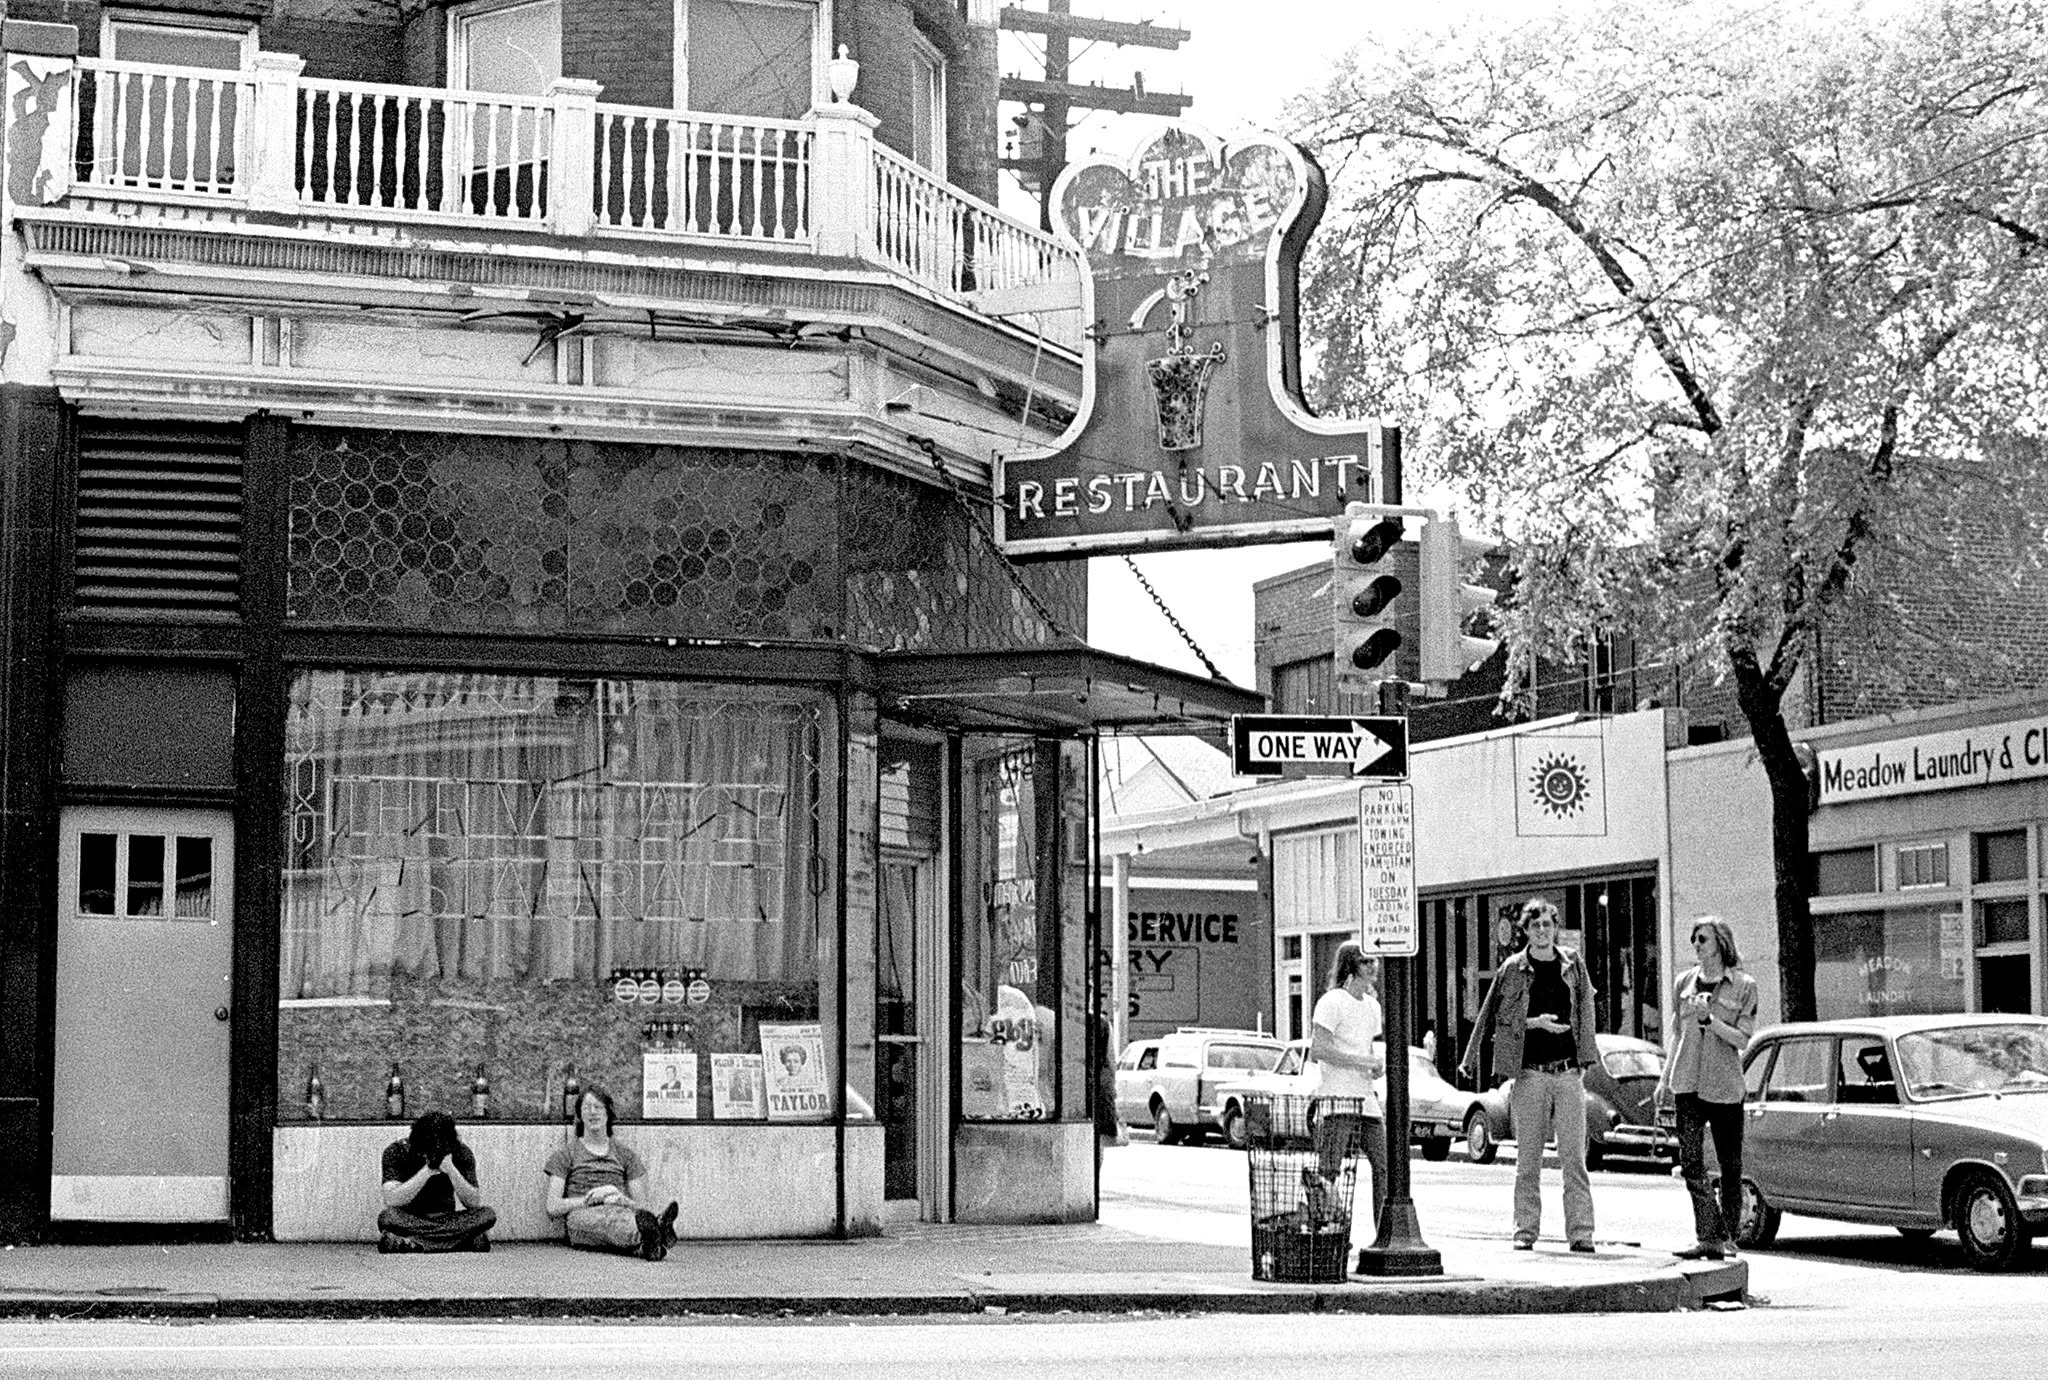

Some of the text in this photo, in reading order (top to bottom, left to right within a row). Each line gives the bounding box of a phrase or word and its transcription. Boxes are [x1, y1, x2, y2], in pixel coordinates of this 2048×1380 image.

[1143, 156, 1209, 200] THE
[1078, 185, 1280, 258] VILLAGE
[1018, 453, 1358, 520] RESTAURANT
[1258, 735, 1362, 759] ONE WAY
[1824, 752, 1907, 795] Meadow
[1913, 739, 1995, 783] Laundry
[2000, 735, 2014, 769] &
[1379, 790, 1393, 801] NO
[1364, 802, 1409, 815] PARKING
[1369, 827, 1405, 840] TOWING
[1364, 841, 1411, 856] ENFORCED
[1380, 871, 1396, 884] ON
[1369, 886, 1408, 899] TUESDAY
[1368, 902, 1410, 913] LOADING
[1377, 913, 1400, 923] ZONE
[1128, 911, 1239, 943] SERVICE
[769, 1094, 829, 1111] TAYLOR
